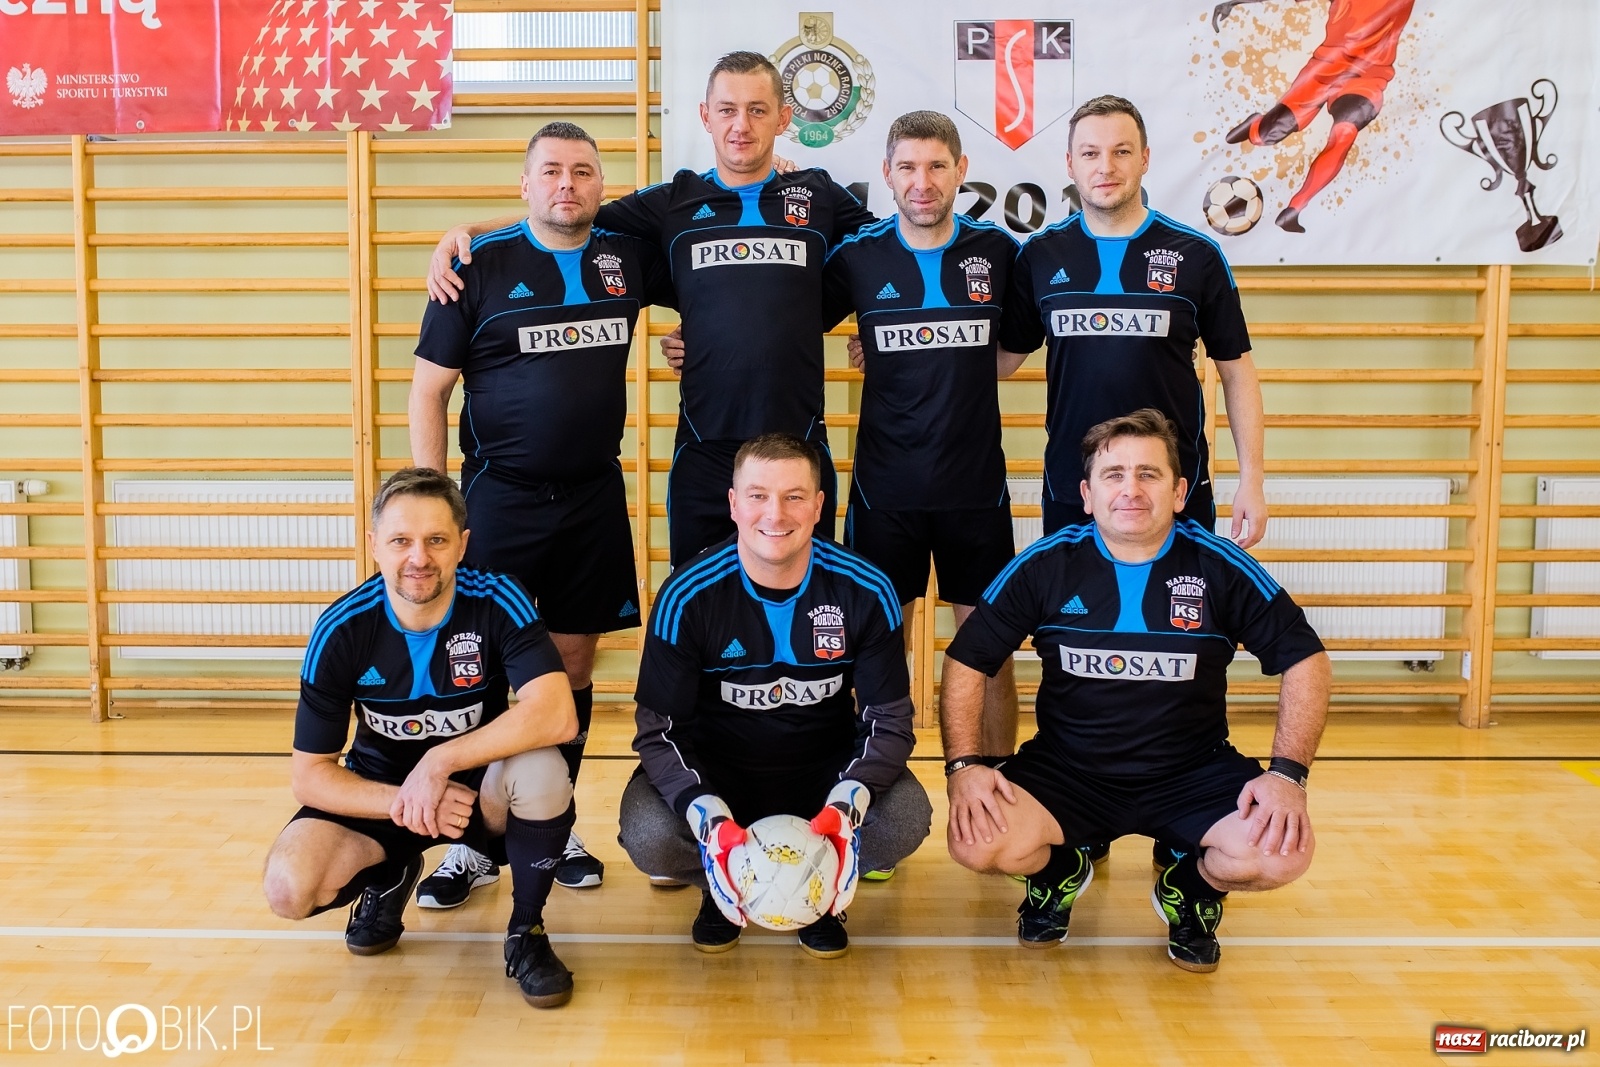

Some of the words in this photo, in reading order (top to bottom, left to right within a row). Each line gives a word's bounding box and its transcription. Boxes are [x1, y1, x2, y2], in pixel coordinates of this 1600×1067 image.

[56, 73, 140, 84] MINISTERSTWO
[789, 53, 812, 72] PIŁKI
[825, 76, 851, 118] RACIBÓRZ
[57, 88, 99, 98] SPORTU
[103, 88, 107, 98] I
[110, 86, 168, 98] TURYSTYKI
[803, 131, 829, 141] 1964
[778, 186, 813, 198] APRZÓD
[788, 203, 807, 218] KS
[699, 242, 800, 265] PROSAT
[1143, 249, 1185, 263] NAPRZÓD
[958, 256, 992, 270] NAPRZÓD
[1149, 255, 1178, 267] BORUCIN
[605, 275, 623, 287] KS
[1151, 270, 1173, 285] KS
[970, 280, 990, 294] KS
[508, 290, 535, 299] adidas
[876, 291, 901, 300] adidas
[1056, 312, 1162, 333] PROSAT
[527, 322, 624, 350] PROSAT
[882, 324, 984, 348] PROSAT
[1172, 583, 1204, 597] BORUCIN
[1060, 606, 1089, 615] adidas
[1174, 604, 1199, 620] KS
[813, 613, 844, 626] BORUCIN
[817, 635, 842, 649] KS
[454, 662, 479, 677] KS
[1067, 651, 1188, 678] PROSAT
[357, 678, 386, 686] adidas
[730, 681, 837, 706] PROSAT
[367, 709, 476, 737] PROSAT
